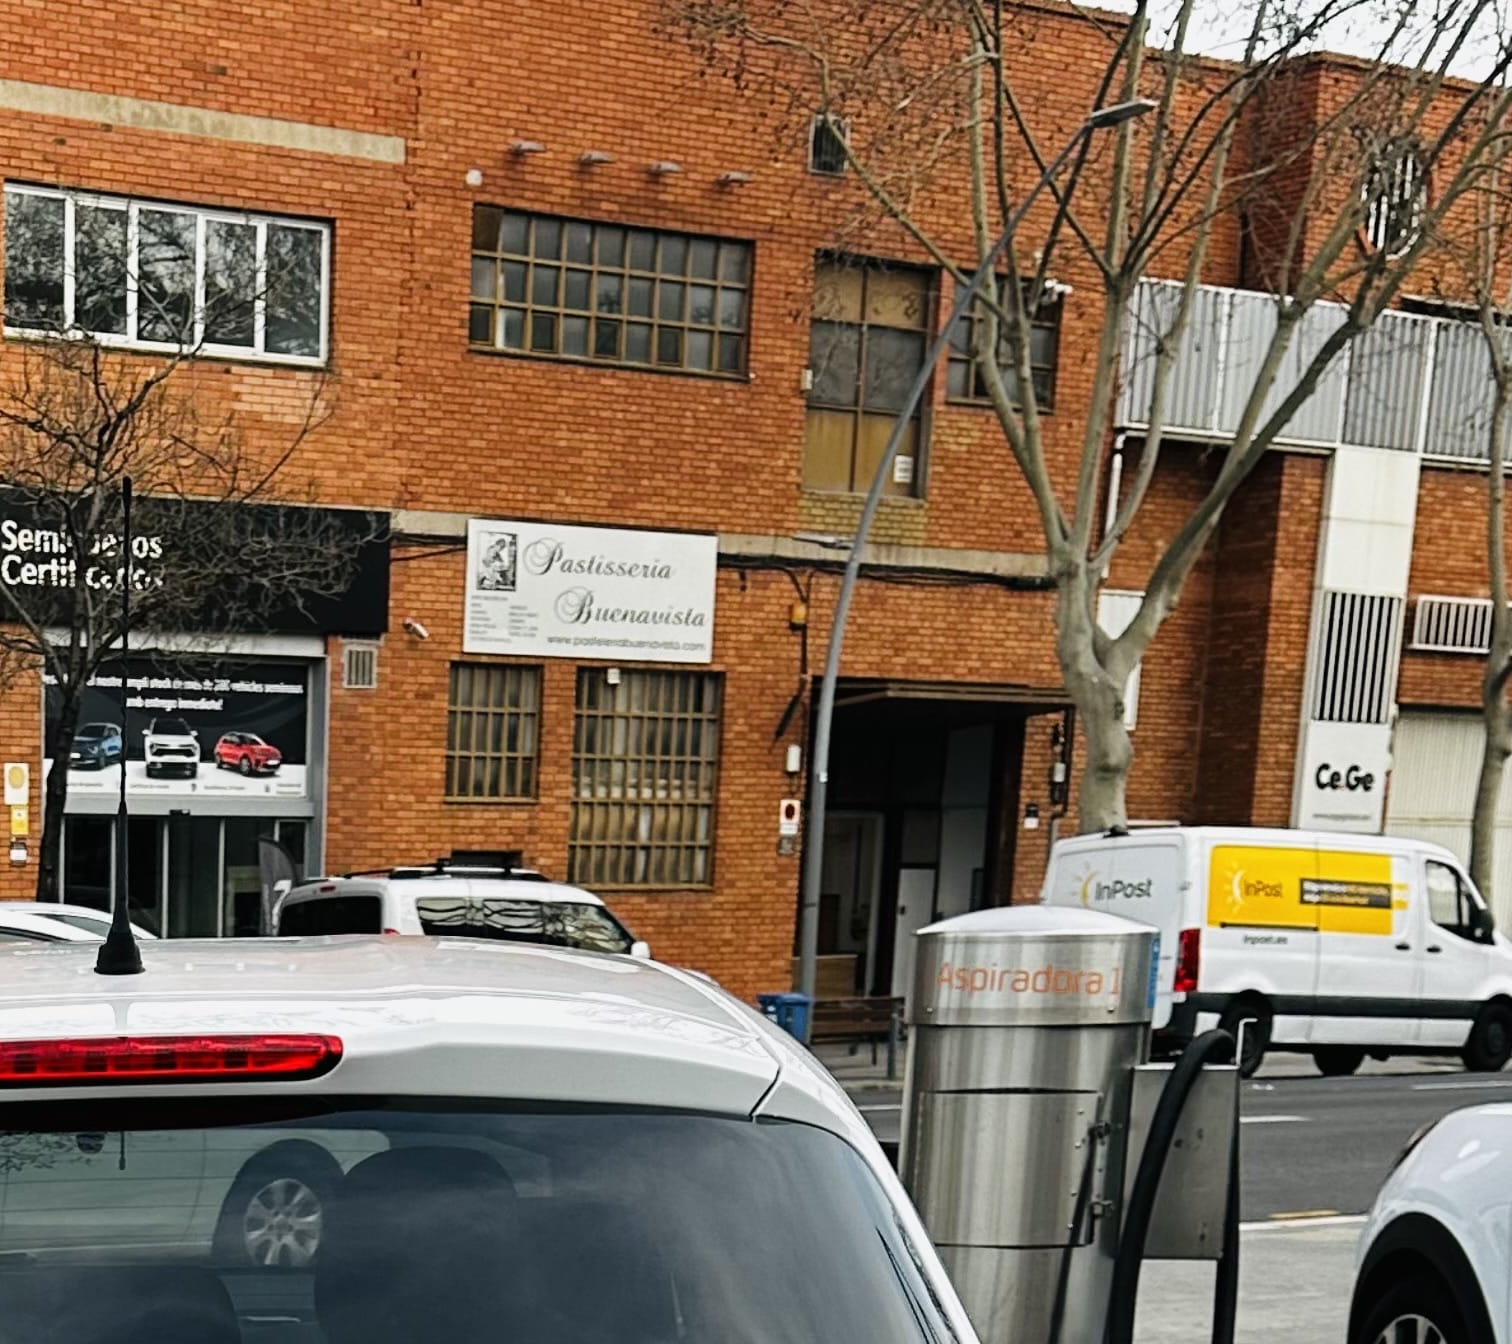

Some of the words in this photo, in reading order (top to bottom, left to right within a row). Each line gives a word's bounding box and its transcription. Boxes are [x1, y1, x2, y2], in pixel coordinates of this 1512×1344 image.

[522, 536, 672, 580] Pastisseria
[554, 585, 706, 627] Buenavista
[1095, 878, 1153, 901] InPost
[937, 961, 1104, 996] Aspiradora
